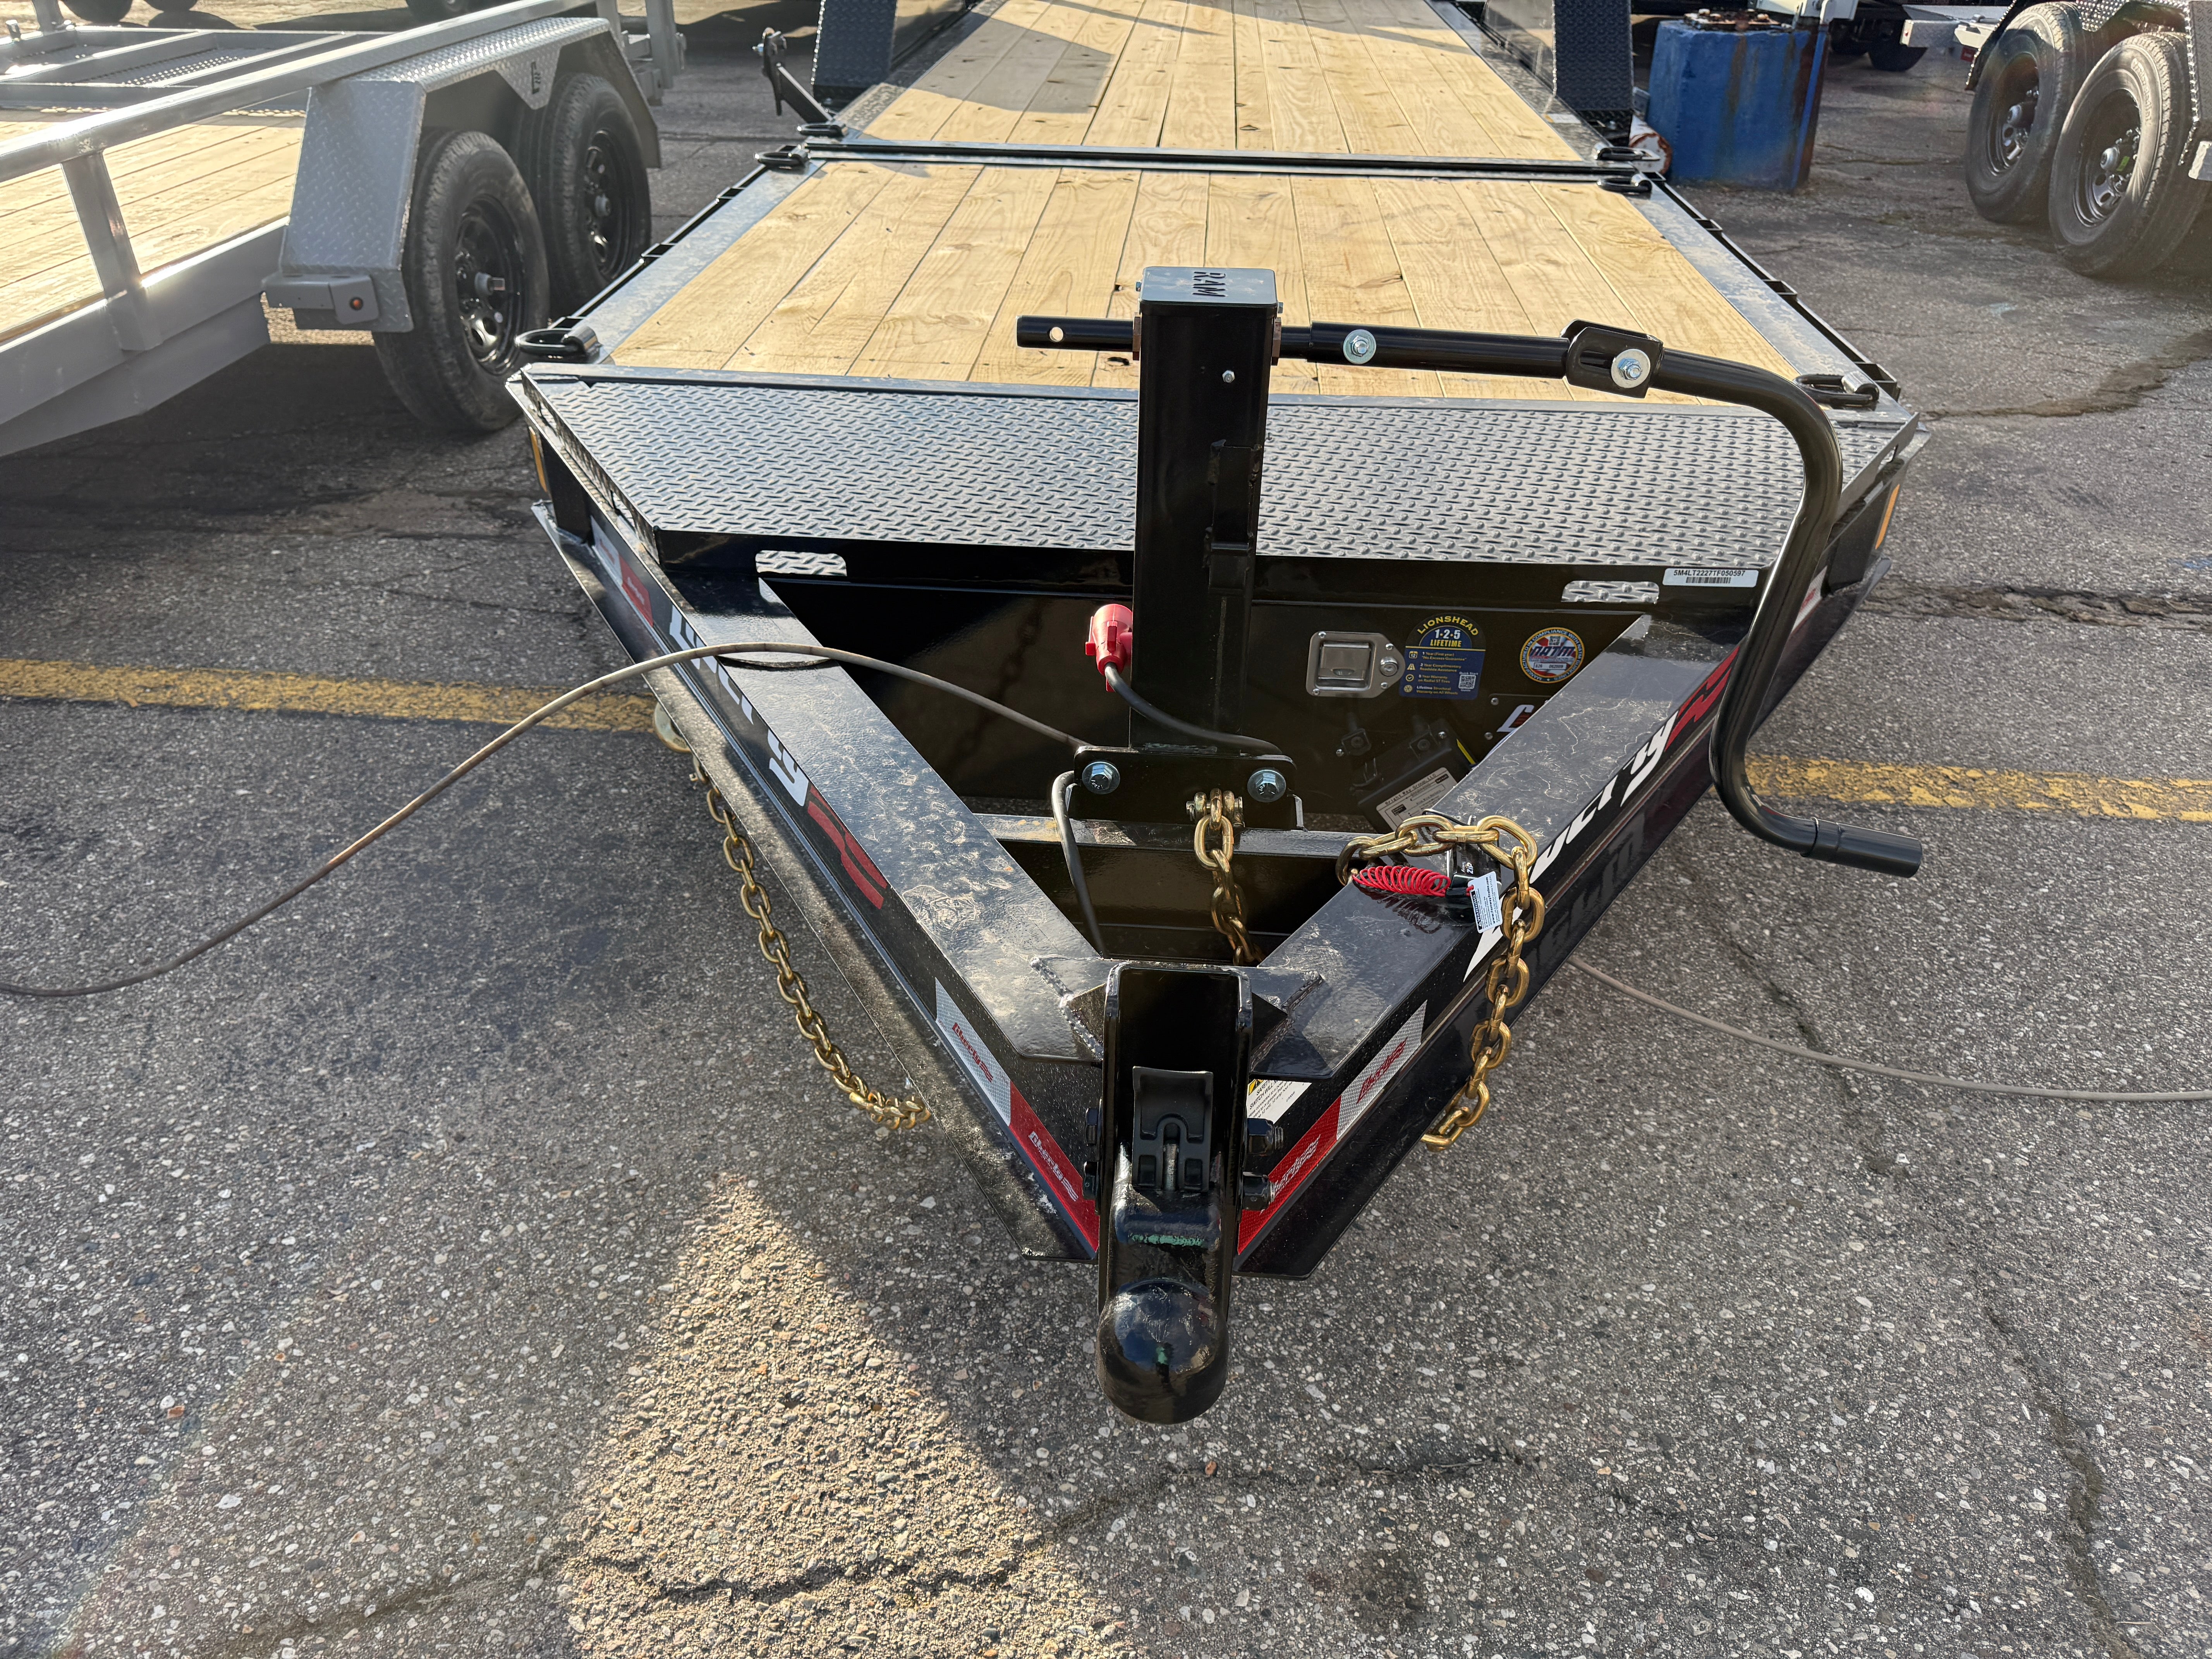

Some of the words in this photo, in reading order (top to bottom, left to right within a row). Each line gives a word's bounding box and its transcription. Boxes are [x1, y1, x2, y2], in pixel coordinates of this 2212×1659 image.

[1192, 271, 1226, 297] RAM
[1417, 616, 1479, 635] LIONSHEAD
[1430, 639, 1462, 647] LIFETIME
[1532, 630, 1568, 643] COMPLIANCE
[1568, 632, 1578, 644] WITH
[1385, 793, 1401, 806] Bright
[1403, 788, 1411, 796] Way
[1250, 1092, 1264, 1110] SWITCH
